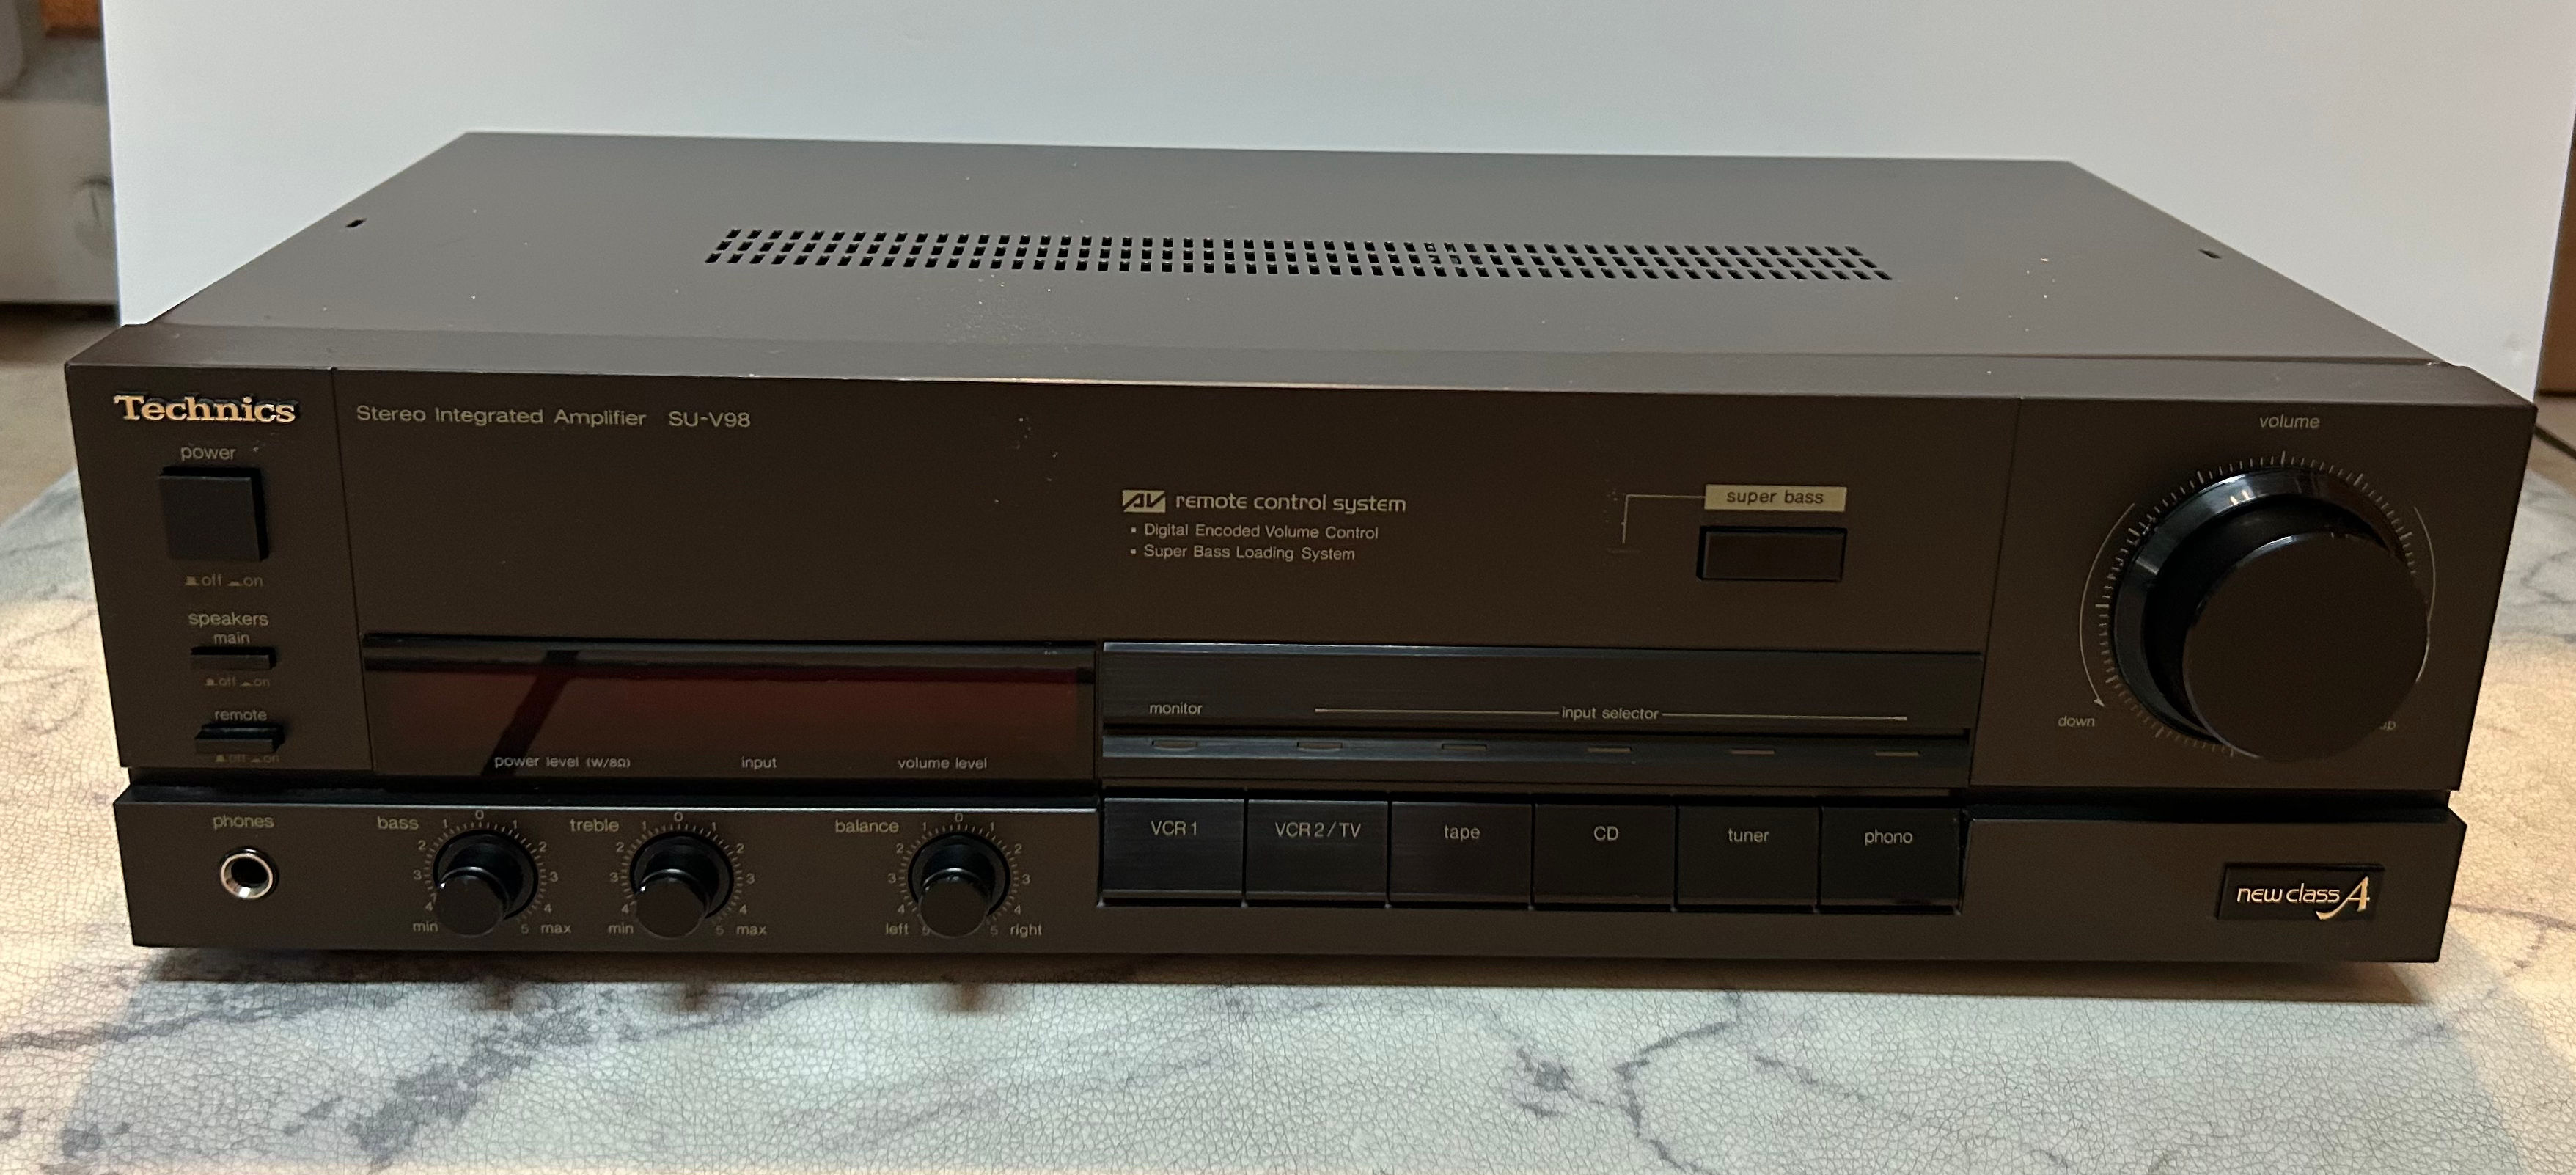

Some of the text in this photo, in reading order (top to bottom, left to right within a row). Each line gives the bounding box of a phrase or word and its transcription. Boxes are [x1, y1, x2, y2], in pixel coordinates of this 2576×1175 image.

[114, 395, 296, 423] Technics
[356, 405, 752, 428] Stereo Integrated Amplifier SU-V98
[2259, 414, 2320, 430] volume
[180, 444, 236, 461] power
[1122, 489, 1406, 514] AV remote control system
[1726, 489, 1824, 505] super bass
[1145, 523, 1379, 540] Digital Encoded Volume Control
[1144, 545, 1355, 563] Super Bass Loading System
[202, 574, 263, 587] off on
[188, 612, 269, 629] speakers
[213, 632, 250, 645] main
[219, 676, 271, 687] off on
[214, 709, 268, 722] remote
[1149, 702, 1203, 716] monitor
[1561, 706, 1659, 722] input selector
[2058, 716, 2096, 728] down
[494, 756, 540, 769] power
[546, 756, 580, 768] level
[741, 755, 777, 770] input
[898, 756, 988, 770] volume level
[213, 814, 274, 830] phones
[377, 816, 419, 830] bass
[570, 818, 620, 832] treble
[835, 819, 899, 833] balance
[1151, 821, 1197, 837] VCR 1
[1274, 822, 1310, 838] VCR
[1444, 825, 1481, 841] tape
[1593, 826, 1619, 842] CD
[1728, 828, 1769, 843] tuner
[1865, 830, 1913, 846] phono
[418, 841, 427, 851] 2
[539, 841, 547, 852] 2
[616, 842, 624, 852] 2
[736, 843, 745, 853] 2
[896, 843, 904, 854] 2
[1014, 843, 1023, 854] 2
[413, 870, 422, 880] 3
[549, 871, 559, 882] 3
[609, 872, 619, 882] 3
[746, 874, 755, 884] 3
[887, 873, 897, 884] 3
[1021, 874, 1031, 885] 3
[2236, 876, 2371, 921] new class A
[425, 902, 433, 912] 4
[543, 904, 552, 913] 4
[621, 904, 629, 914] 4
[739, 904, 747, 915] 4
[897, 904, 906, 914] 4
[1014, 905, 1021, 915] 4
[412, 921, 439, 932] min
[540, 924, 571, 934] max
[608, 923, 634, 934] min
[735, 926, 767, 935] max
[885, 923, 909, 935] left
[1010, 923, 1043, 938] right
